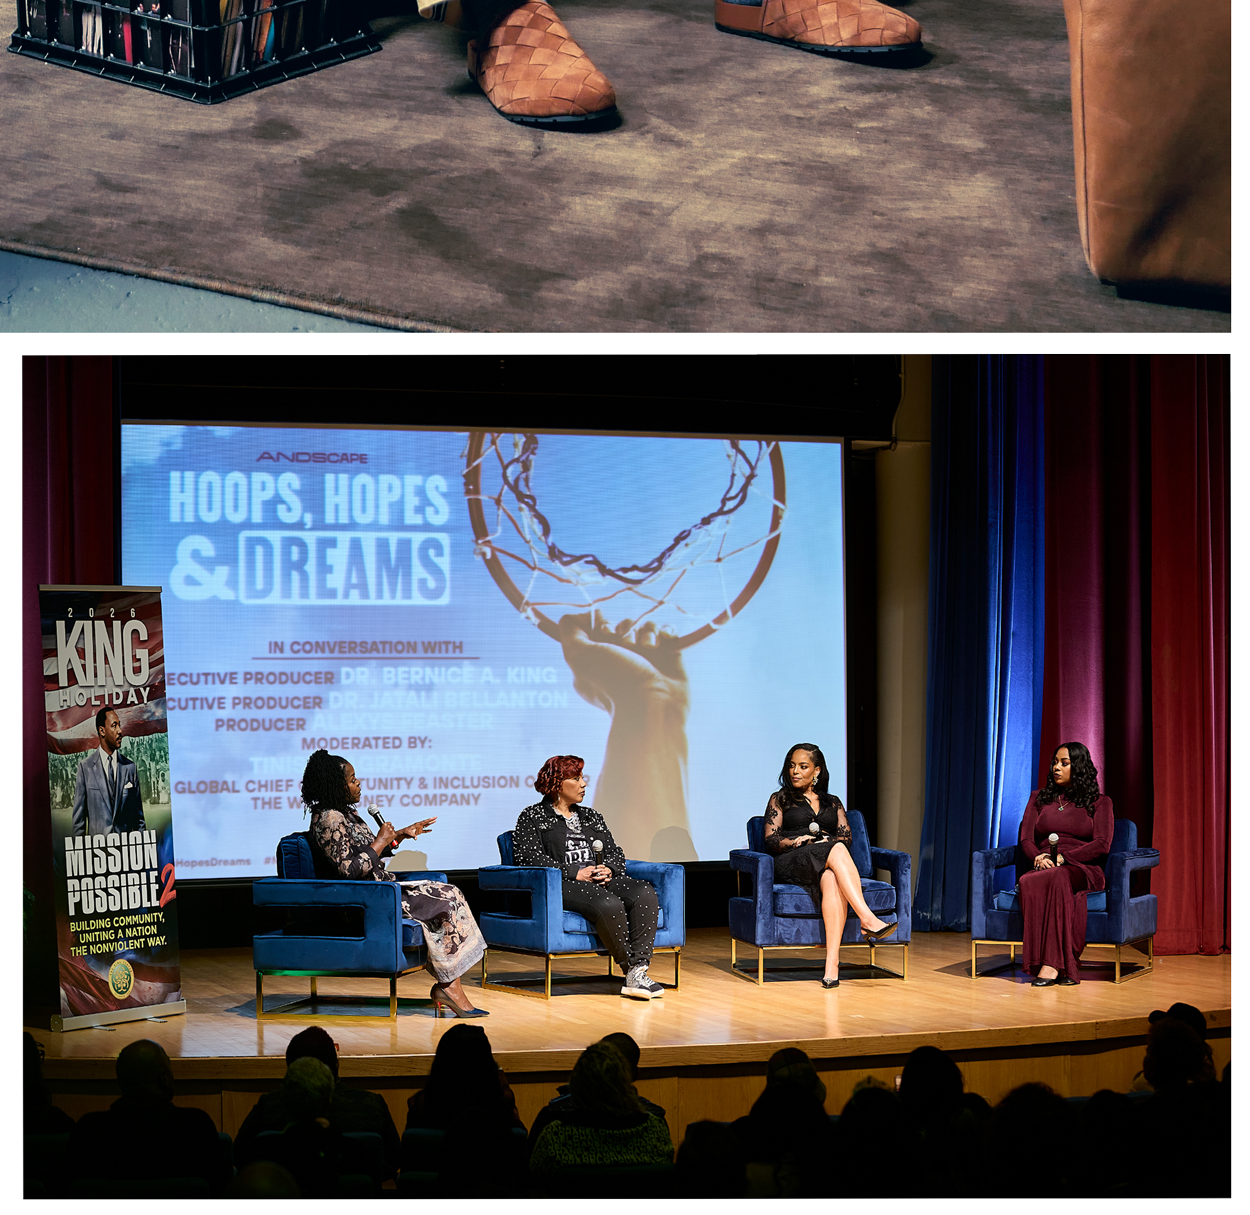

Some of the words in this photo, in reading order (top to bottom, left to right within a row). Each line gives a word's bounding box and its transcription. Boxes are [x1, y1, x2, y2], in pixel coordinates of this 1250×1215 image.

[256, 451, 368, 464] ANDSCAPE
[168, 470, 313, 529] HOOPS,
[323, 472, 450, 526] HOPES
[168, 534, 236, 601] &
[243, 535, 448, 601] DREAMS
[55, 619, 150, 687] KING
[268, 640, 284, 654] IN
[290, 640, 417, 654] CONVERSATION
[421, 640, 464, 655] WITH
[166, 671, 238, 686] ECUTIVE
[243, 671, 335, 685] PRODUCER
[340, 666, 376, 685] DR.
[382, 665, 475, 685] BERNICE
[480, 666, 501, 684] A.
[506, 666, 558, 684] KING
[59, 687, 150, 707] HOLIDAY
[166, 696, 226, 711] CUTIVE
[231, 696, 323, 710] PRODUCER
[214, 717, 306, 732] PRODUCER
[301, 736, 402, 750] MODERATED
[407, 736, 432, 749] BY:
[359, 754, 482, 773] GRAMONTE
[174, 780, 241, 794] GLOBAL
[245, 779, 294, 793] CHIEF
[418, 776, 428, 790] &
[433, 775, 521, 790] INCLUSION
[250, 796, 283, 810] THE
[399, 793, 482, 807] COMPANY
[64, 829, 159, 878] MISSION
[66, 870, 161, 916] POSSIBLE
[159, 862, 177, 908] 2
[70, 917, 111, 932] BUILDING
[113, 911, 165, 927] COMMUNITY,
[79, 929, 116, 944] UNITING
[117, 928, 124, 939] A
[125, 924, 158, 938] NATION
[70, 945, 88, 957] THE
[89, 937, 146, 955] NONVIOLENT
[147, 935, 168, 947] WAY.
